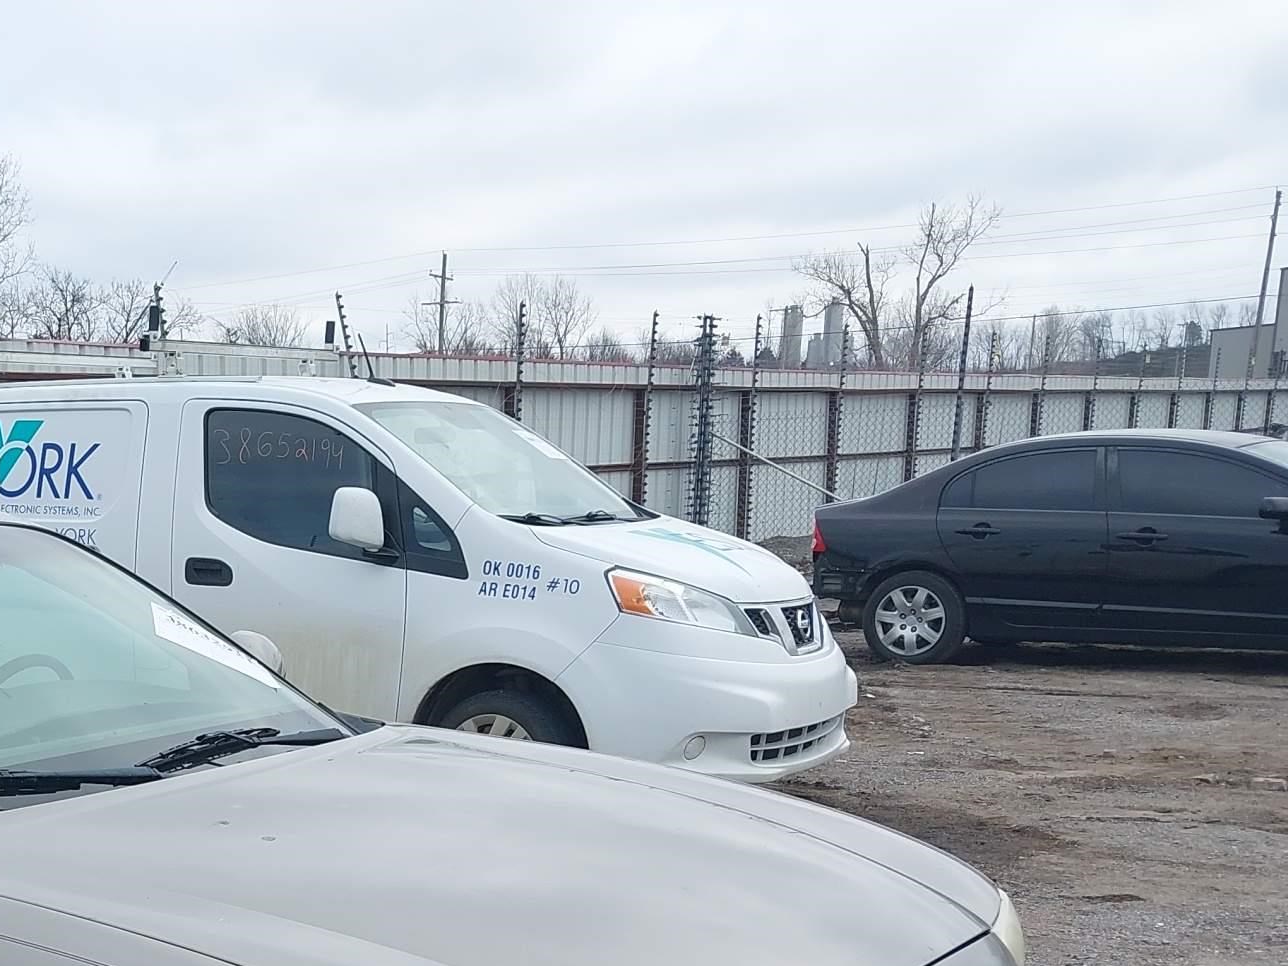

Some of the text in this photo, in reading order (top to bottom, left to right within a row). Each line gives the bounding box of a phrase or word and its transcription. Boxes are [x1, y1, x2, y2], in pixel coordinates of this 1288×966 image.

[213, 427, 344, 469] 38652194
[43, 505, 81, 517] SYSTEMS,
[482, 560, 541, 580] OK 0016
[478, 581, 537, 601] AR E014
[546, 577, 580, 595] #10
